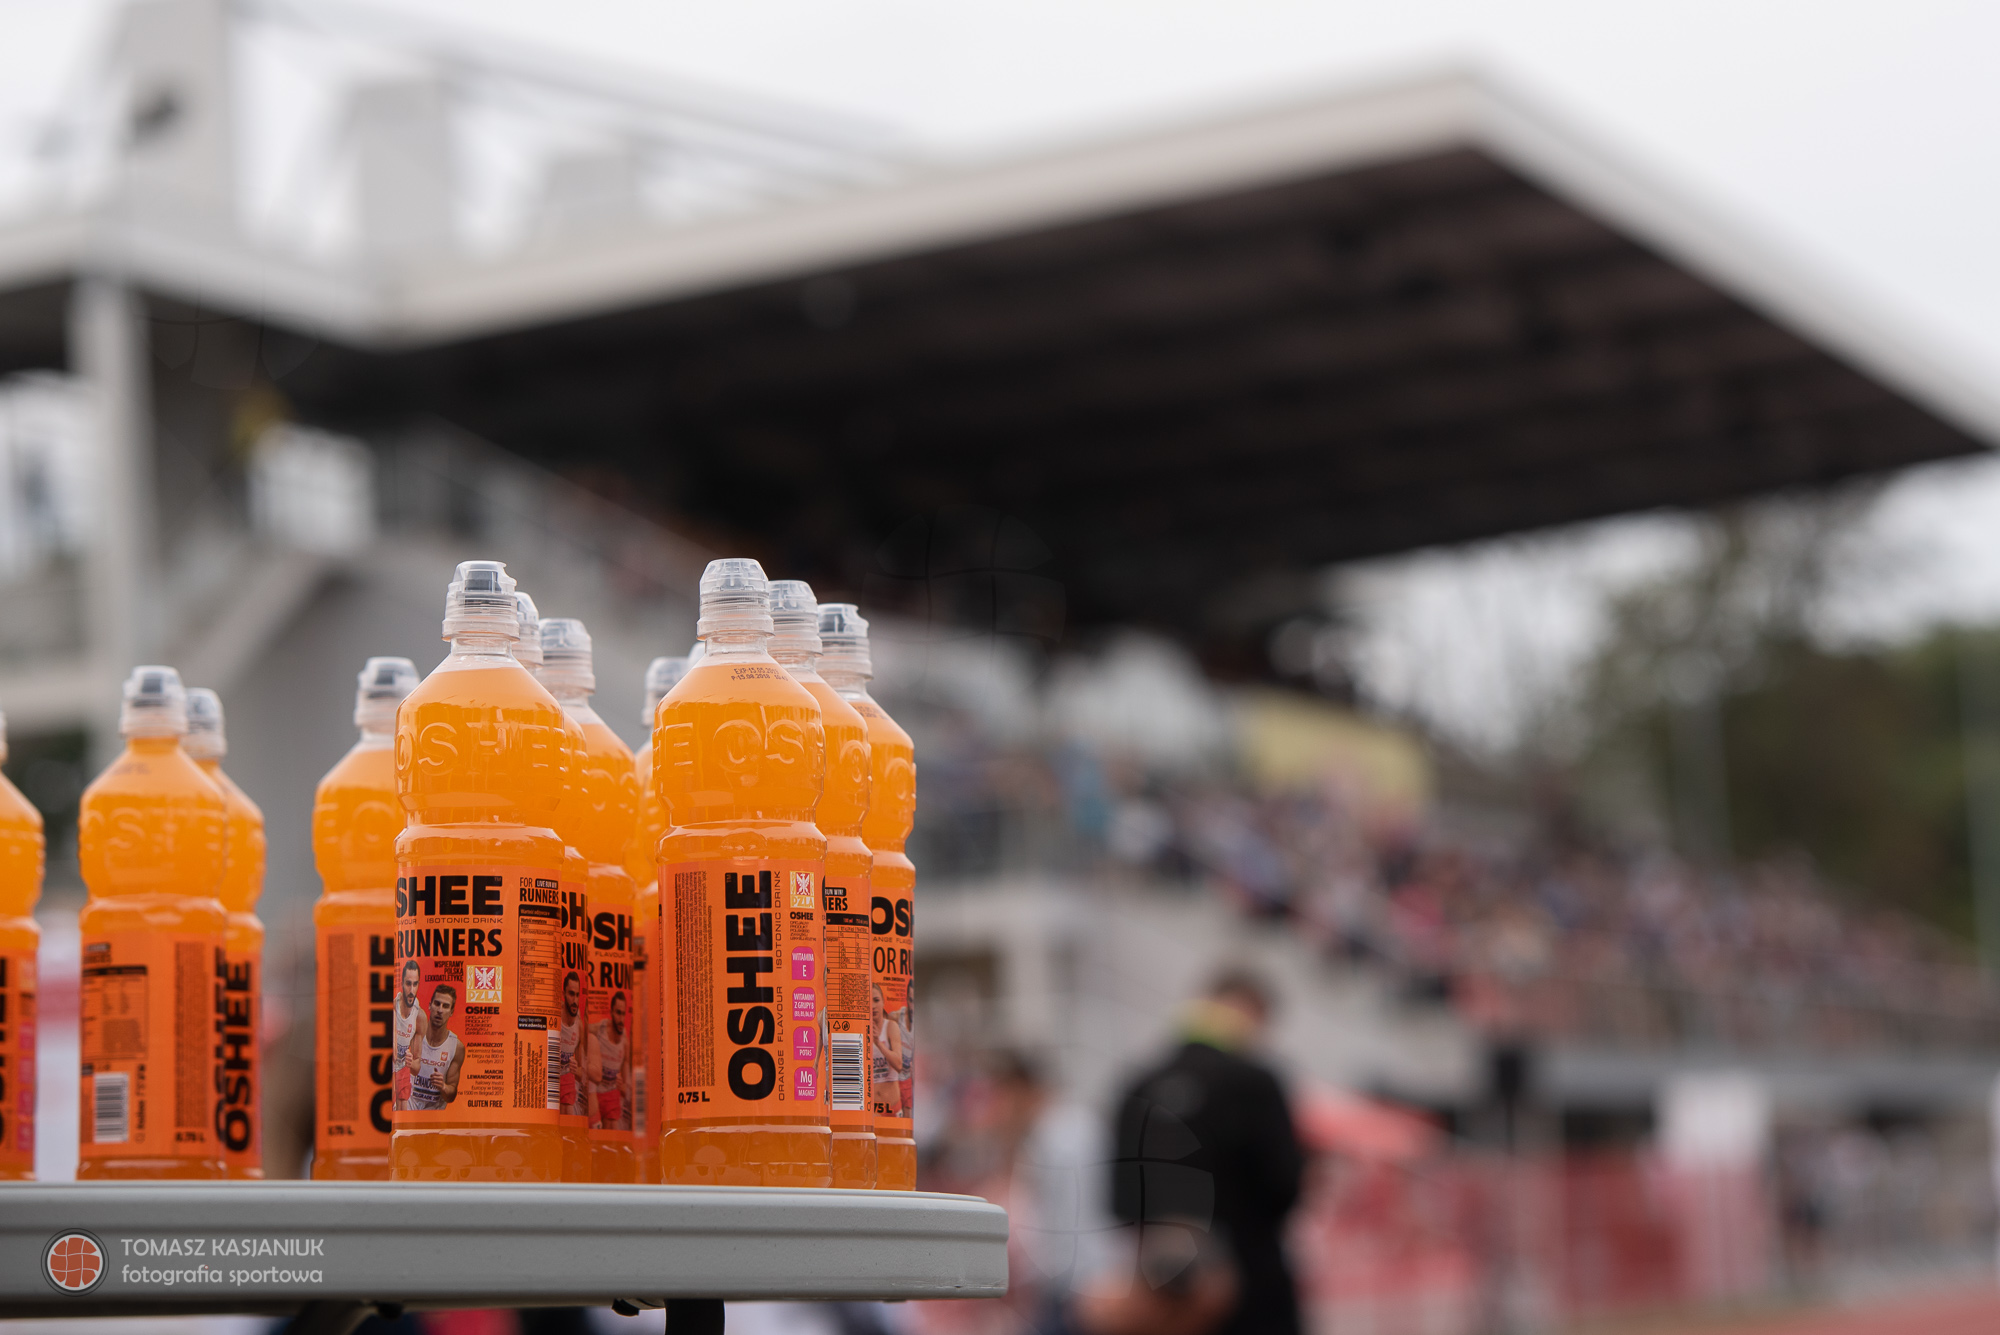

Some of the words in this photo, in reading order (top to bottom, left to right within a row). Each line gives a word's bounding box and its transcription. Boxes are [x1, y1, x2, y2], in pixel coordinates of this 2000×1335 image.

[519, 876, 533, 888] FOR
[396, 875, 503, 918] SHEE
[519, 887, 559, 905] RUNNERS
[824, 897, 848, 911] ERS
[789, 911, 814, 921] OSHEE
[397, 928, 503, 959] RUNNERS
[792, 952, 814, 962] WITAMINA
[802, 965, 807, 977] E
[725, 870, 777, 1102] OSHEE
[467, 990, 501, 1002] PZLA
[465, 1006, 500, 1015] OSHEE
[776, 986, 784, 1043] FLAVOUR
[803, 1030, 809, 1043] K
[225, 961, 250, 1152] OSHEE
[799, 1048, 812, 1057] POTAS
[800, 1070, 813, 1087] Mg
[677, 1091, 700, 1104] 0,75
[701, 1091, 711, 1103] L
[798, 1088, 815, 1097] MAGNEZ
[467, 1099, 489, 1108] GLUTEN
[489, 1099, 503, 1108] FREE
